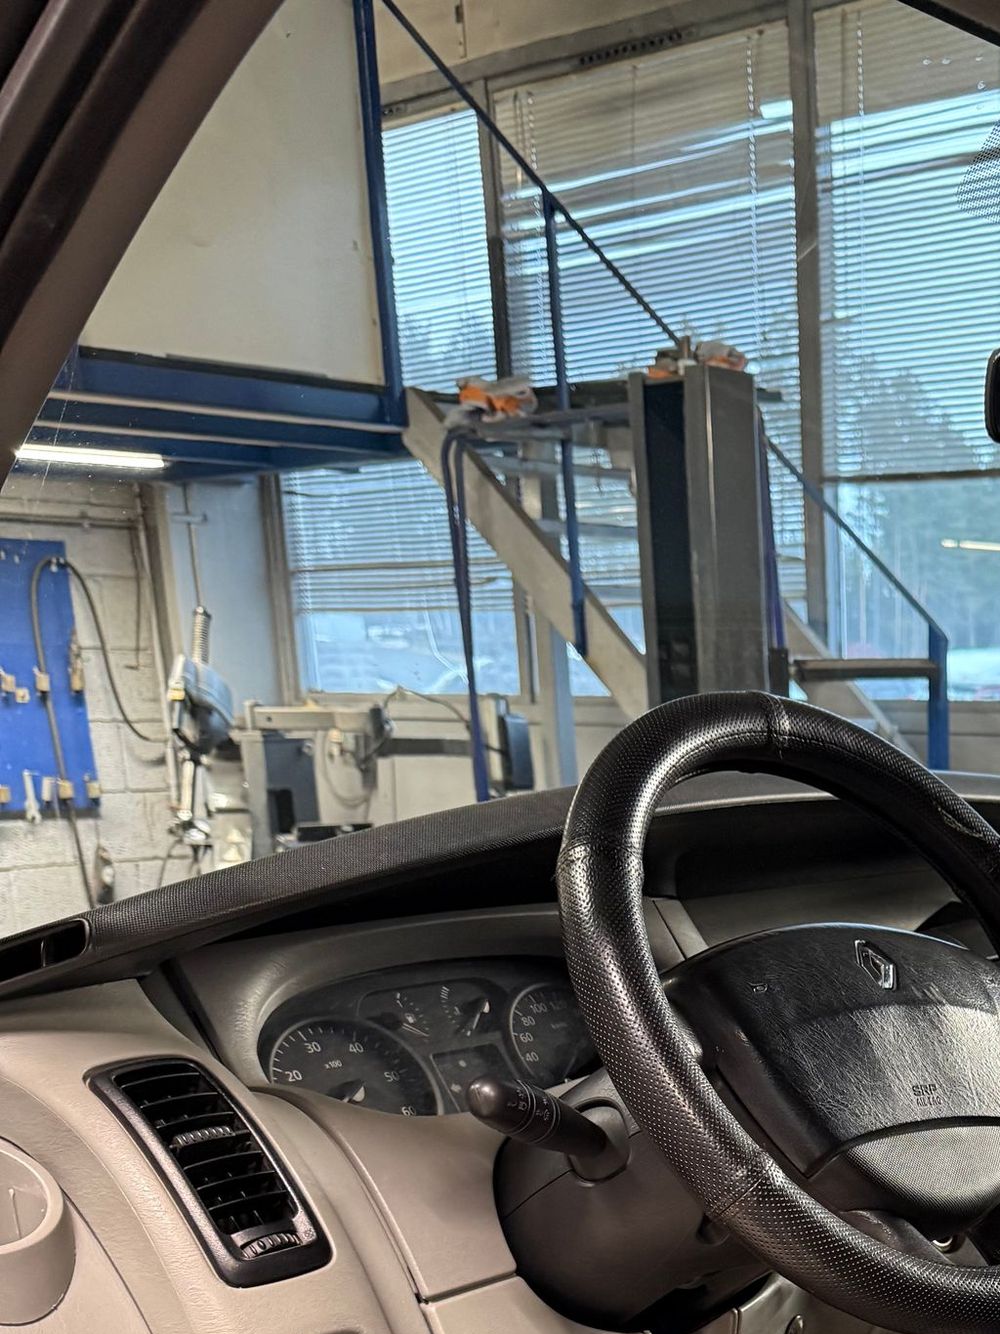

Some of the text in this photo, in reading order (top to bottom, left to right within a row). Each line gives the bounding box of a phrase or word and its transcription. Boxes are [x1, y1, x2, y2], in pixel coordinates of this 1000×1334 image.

[529, 1002, 547, 1014] 100
[521, 1016, 536, 1026] 80
[520, 1032, 534, 1043] 60
[304, 1041, 321, 1053] 30
[349, 1042, 364, 1053] 40
[525, 1051, 539, 1062] 40
[324, 1059, 343, 1070] x100
[285, 1071, 303, 1082] 20
[384, 1071, 400, 1082] 50
[912, 1084, 938, 1096] SRP
